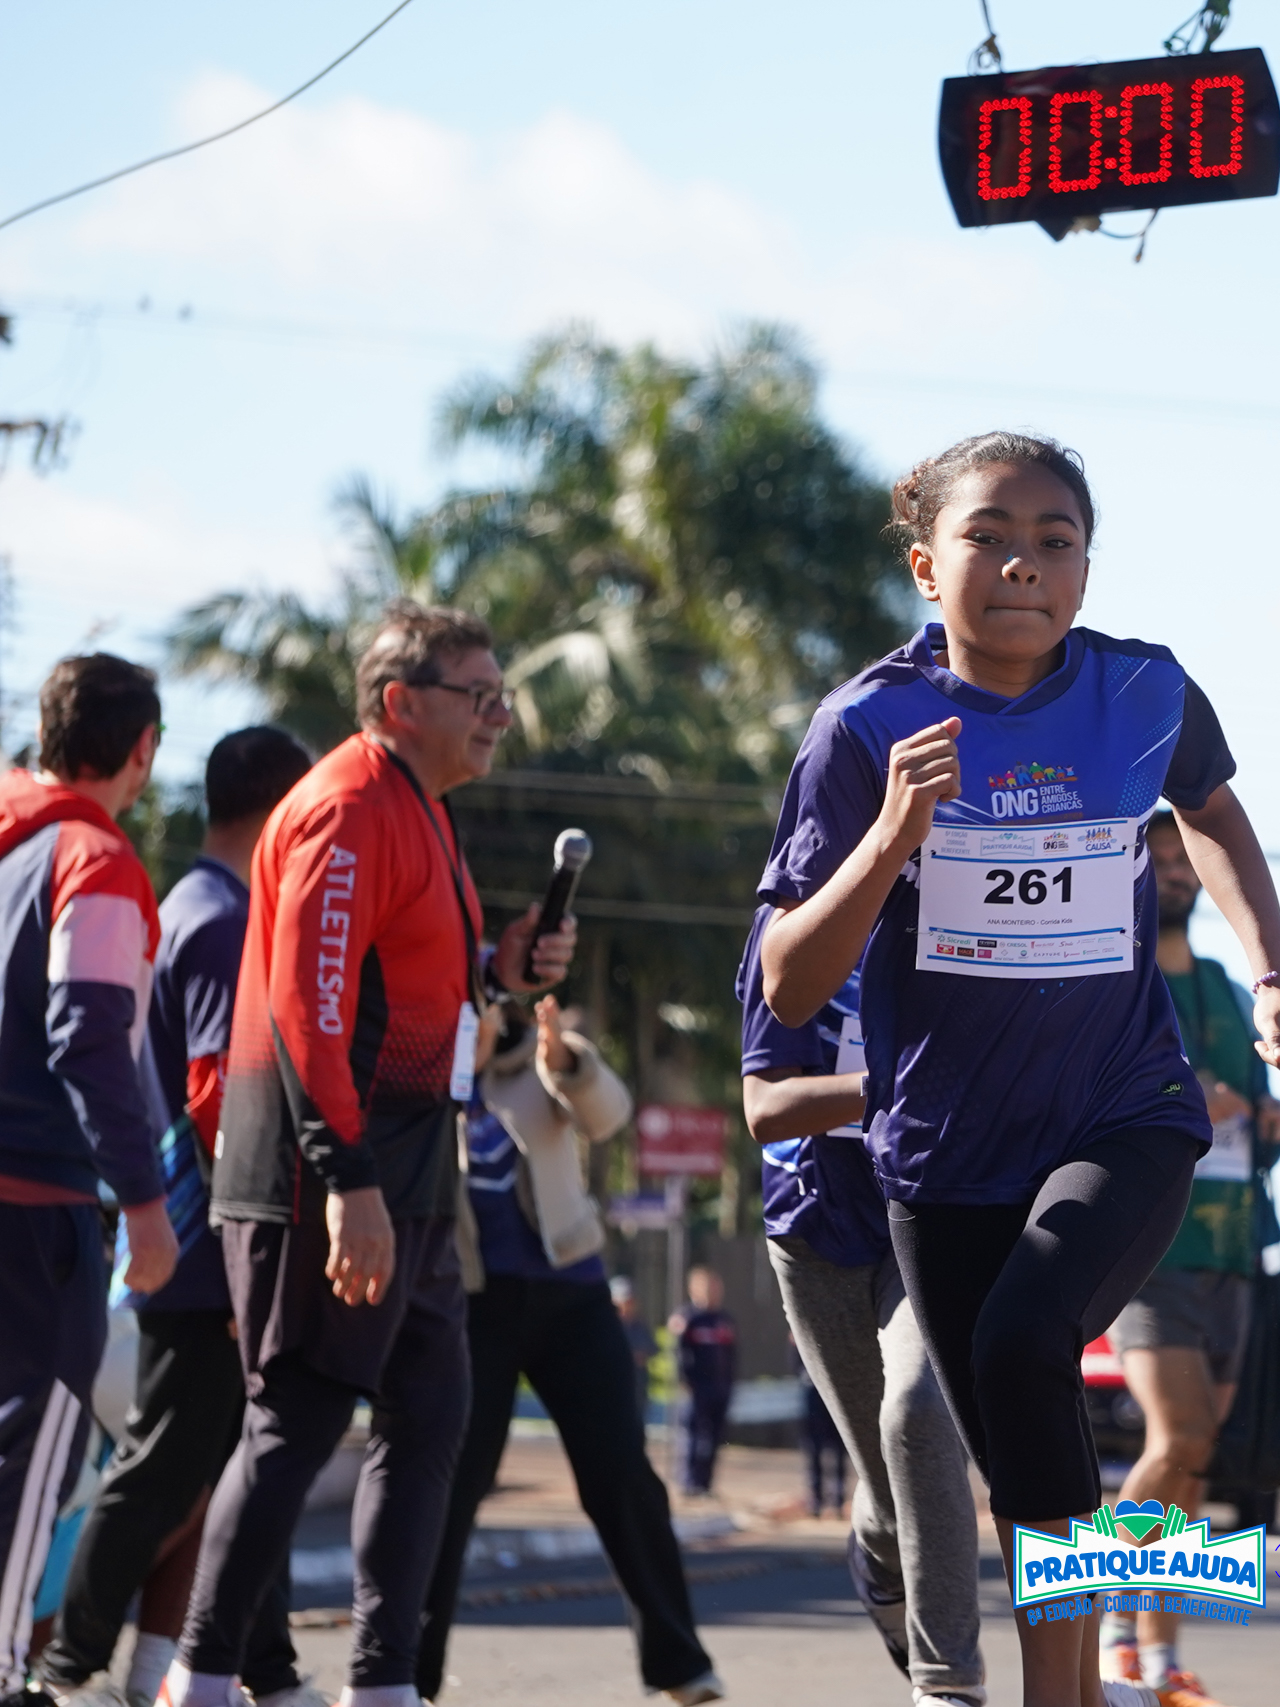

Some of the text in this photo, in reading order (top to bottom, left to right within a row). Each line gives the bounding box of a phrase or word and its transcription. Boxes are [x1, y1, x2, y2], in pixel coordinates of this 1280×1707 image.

[978, 75, 1244, 201] 00:00
[1040, 784, 1066, 796] ENTRE
[991, 788, 1039, 818] ONG
[1041, 791, 1079, 805] AMIGOS E
[982, 843, 1033, 851] PRATIQUE AJUDA
[1043, 840, 1058, 850] ONG
[1085, 842, 1111, 851] CAUSA
[983, 866, 1072, 906] 261
[1040, 918, 1060, 926] Corrida
[317, 843, 357, 1035] ATLETISMO
[946, 936, 972, 945] Sicredi
